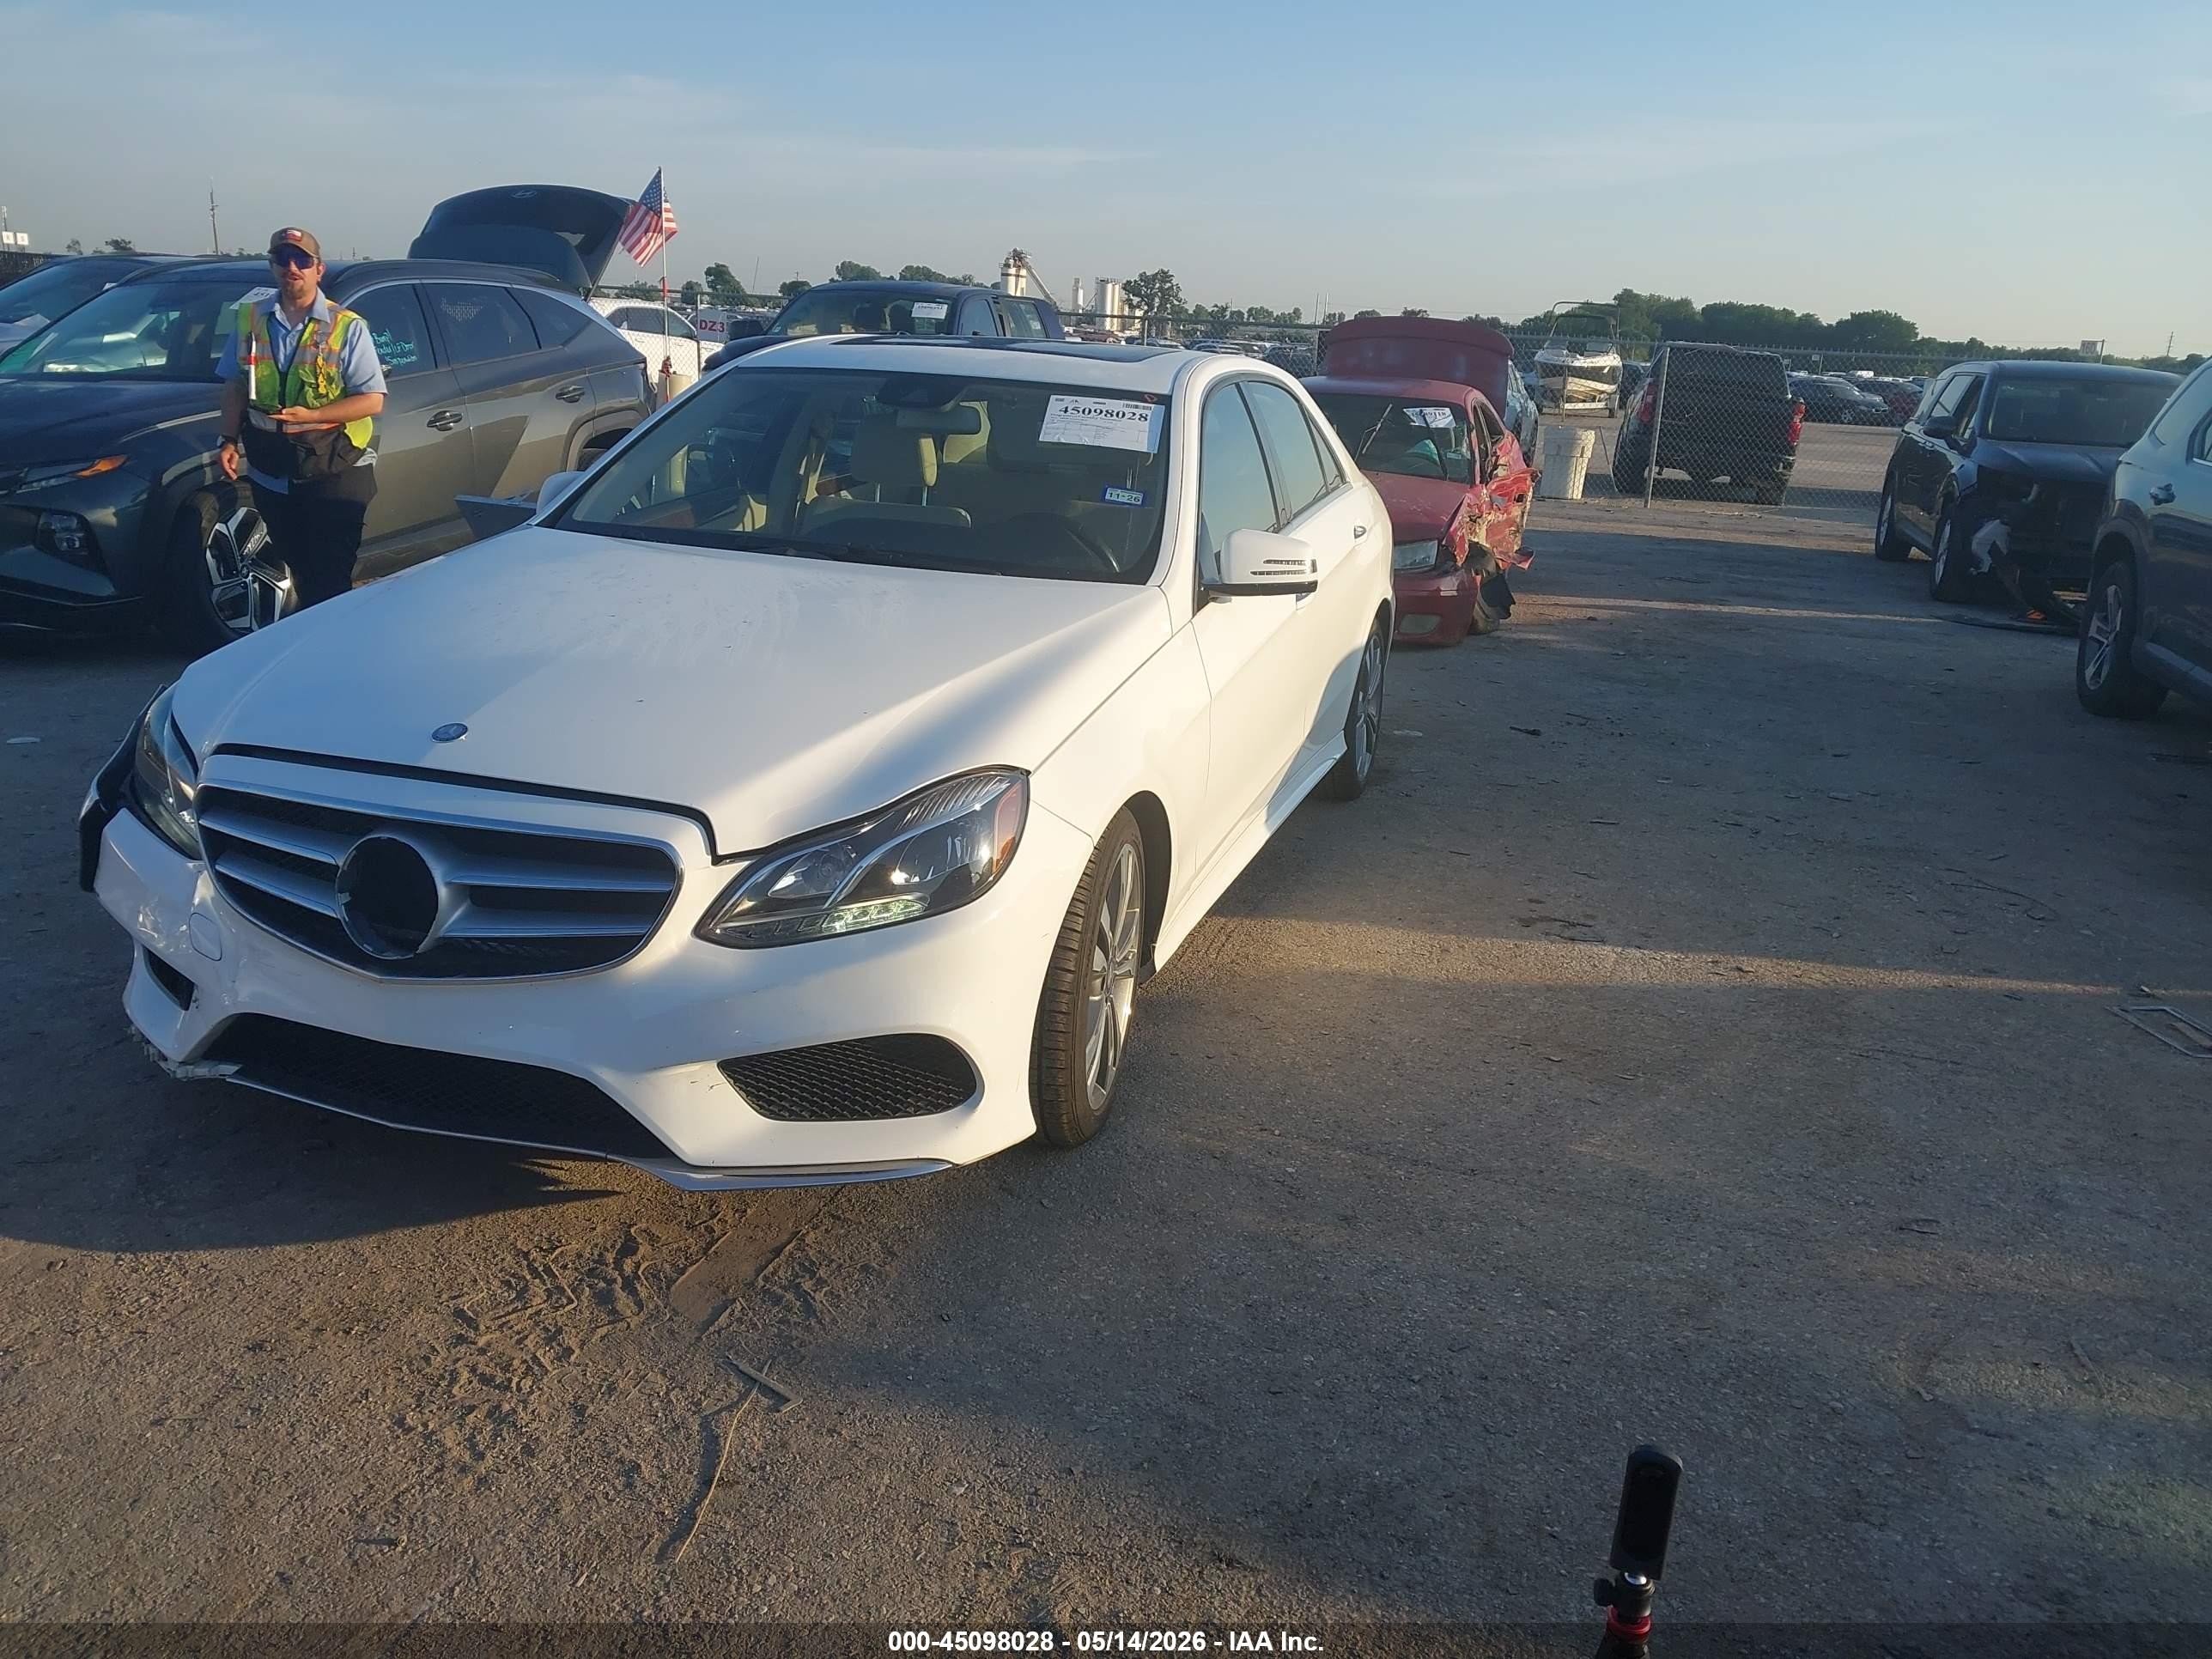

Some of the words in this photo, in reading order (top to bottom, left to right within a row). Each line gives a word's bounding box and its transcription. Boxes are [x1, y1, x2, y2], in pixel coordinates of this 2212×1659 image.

[699, 319, 726, 333] DZ3
[1058, 405, 1149, 422] 45098028
[1109, 491, 1141, 503] 11-26
